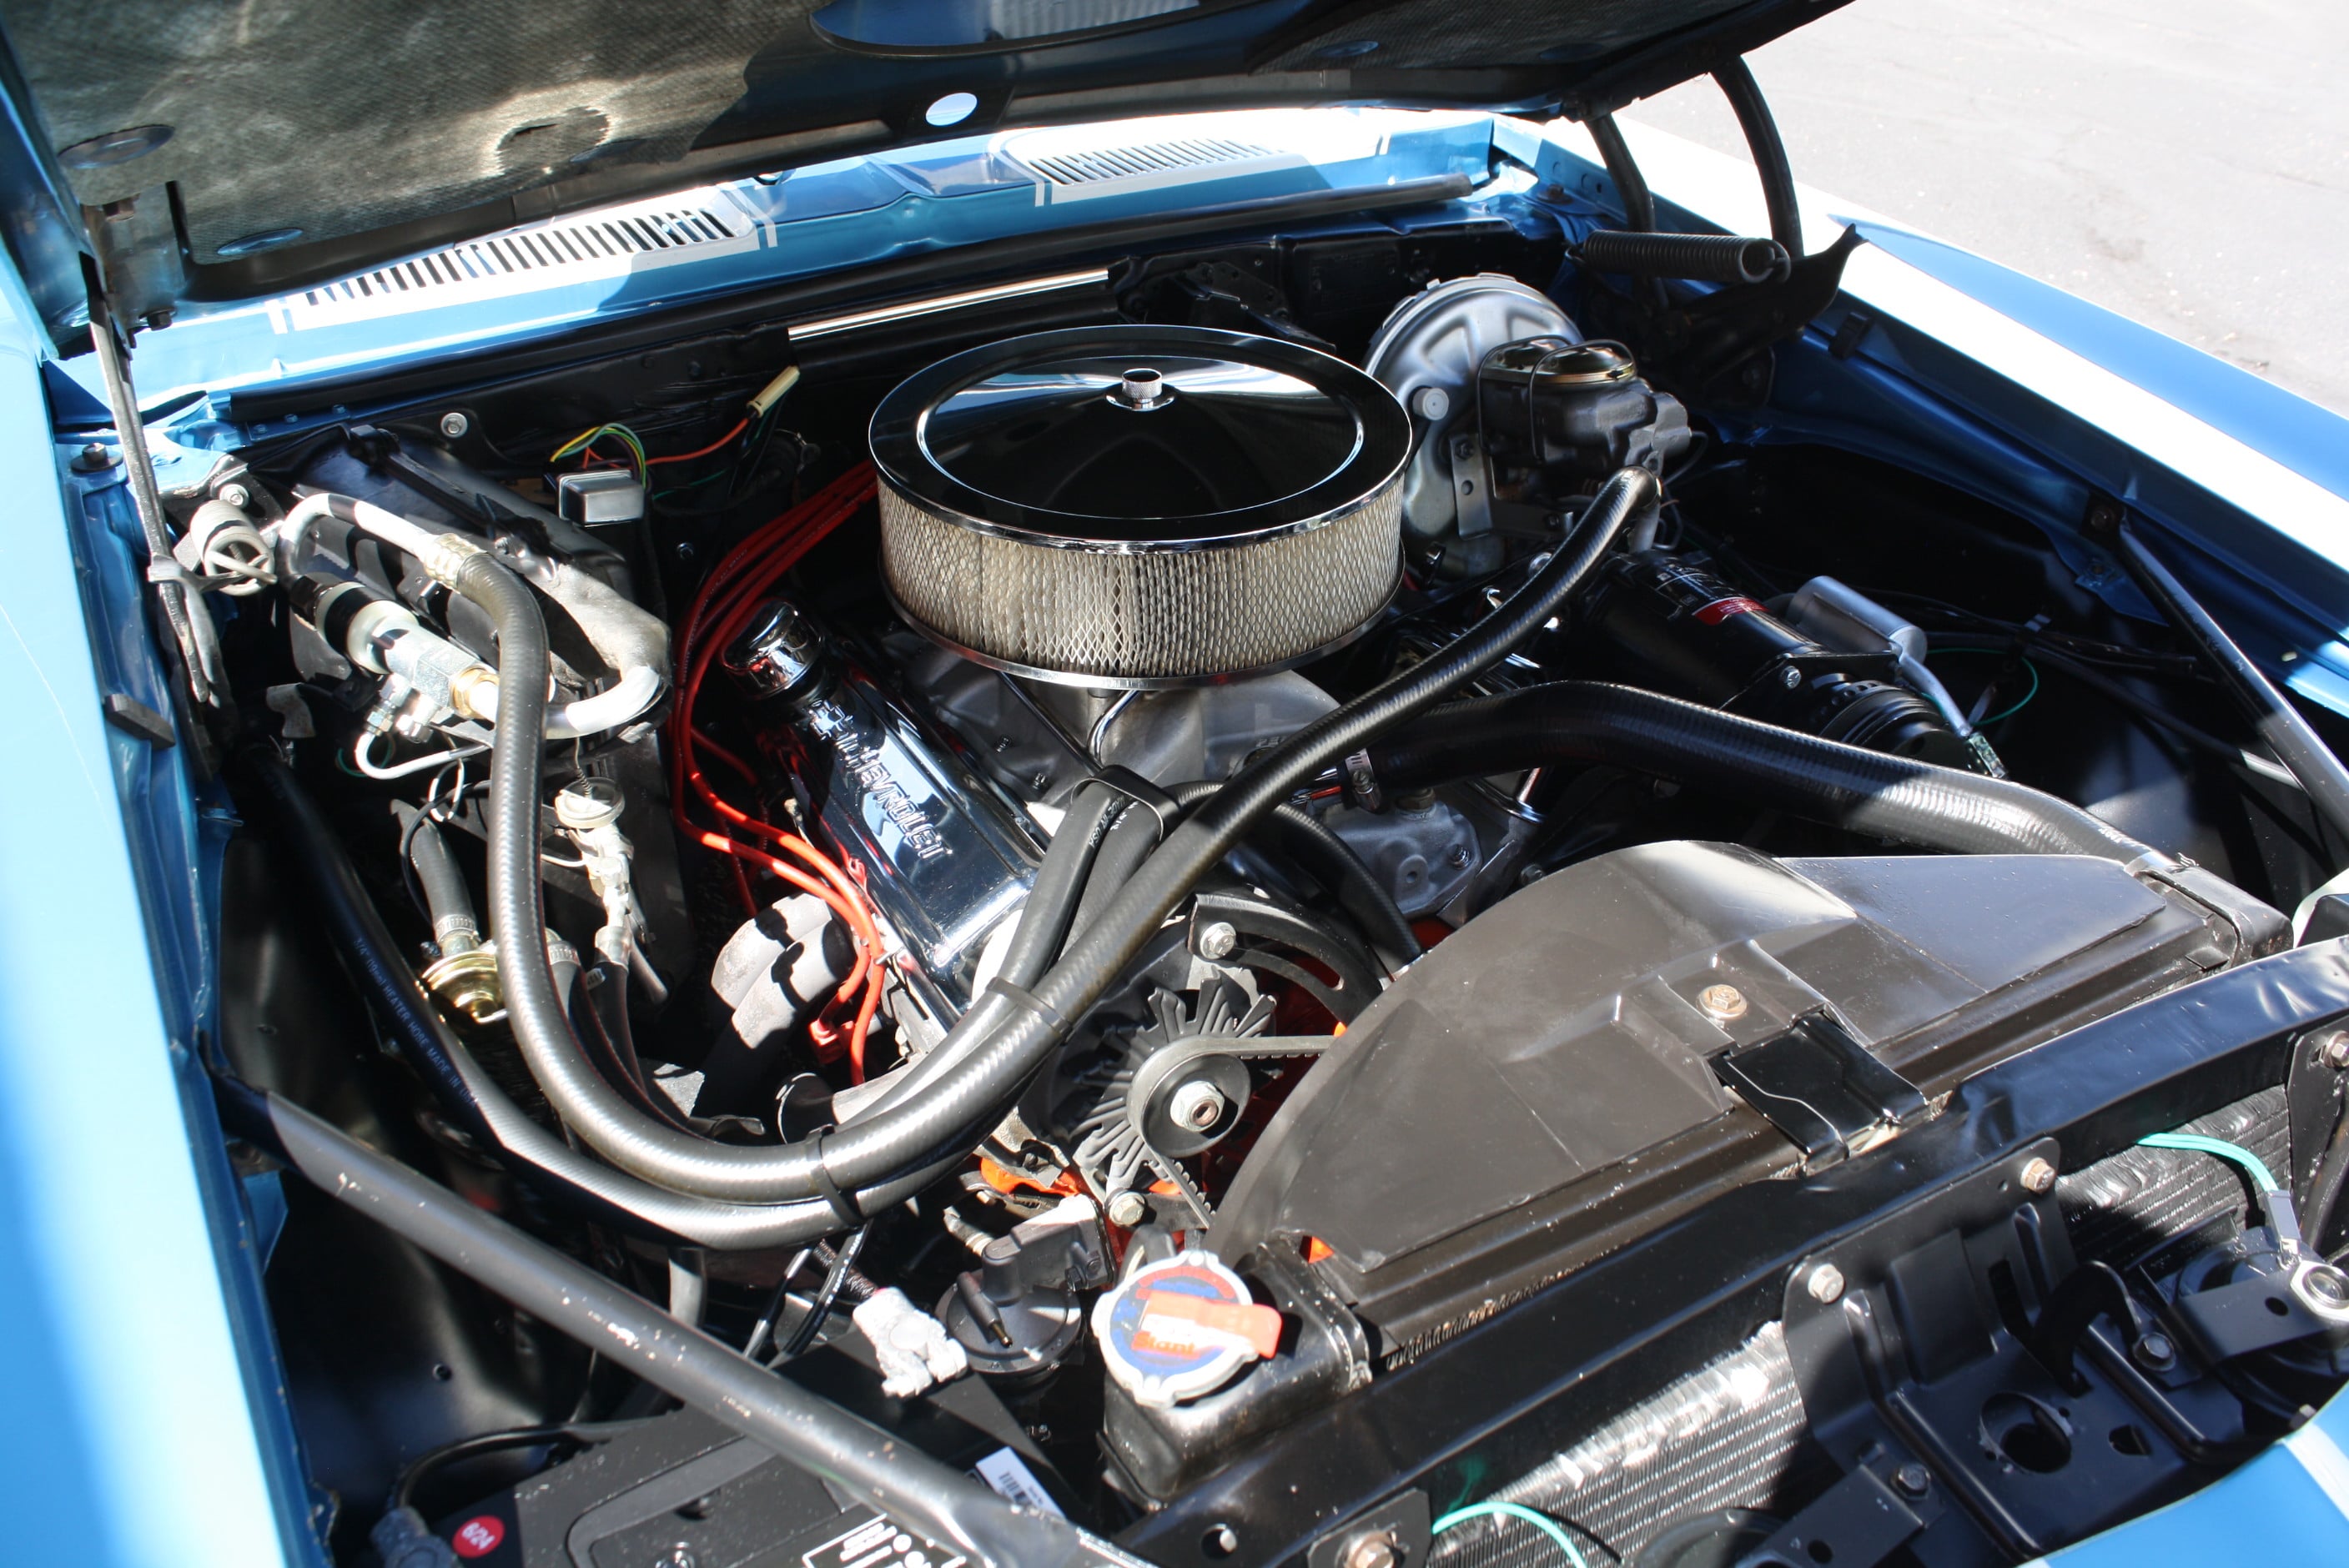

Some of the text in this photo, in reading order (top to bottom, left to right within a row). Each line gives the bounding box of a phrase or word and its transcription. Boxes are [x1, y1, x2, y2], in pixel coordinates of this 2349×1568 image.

[835, 733, 952, 859] CHEVROLET
[1089, 827, 1102, 848] USA
[383, 988, 410, 1022] HEATER
[427, 1049, 451, 1075] MADE
[450, 1073, 462, 1088] IN
[1134, 1331, 1196, 1356] Stant
